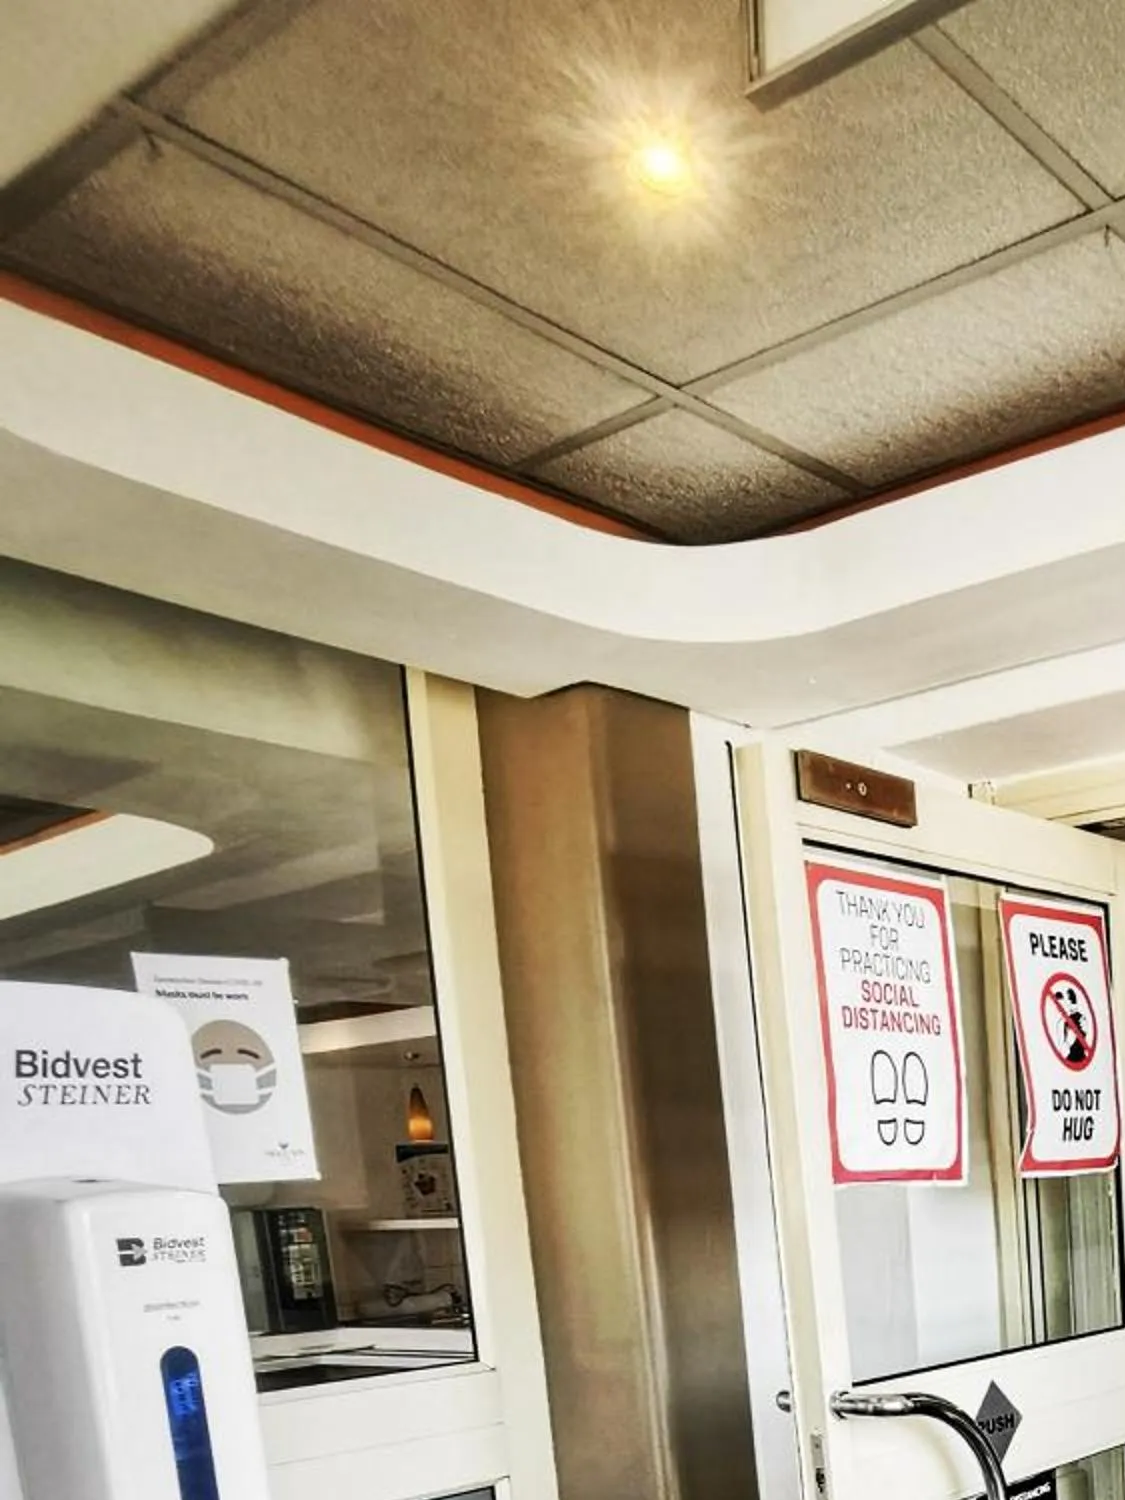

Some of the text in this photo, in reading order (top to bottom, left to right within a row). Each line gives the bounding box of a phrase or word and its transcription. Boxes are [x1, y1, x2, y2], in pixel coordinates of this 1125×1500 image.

[836, 889, 926, 929] THANK YOU
[870, 924, 899, 950] FOR
[1029, 932, 1089, 962] PLEASE
[840, 947, 931, 984] PRACTICING
[861, 979, 920, 1007] SOCIAL
[842, 1005, 942, 1036] DISTANCING
[15, 1049, 143, 1078] Bidvest
[17, 1083, 152, 1107] STEINER
[1052, 1088, 1101, 1112] DO NOT
[1063, 1115, 1095, 1142] HUG
[153, 1237, 205, 1250] Bidvest
